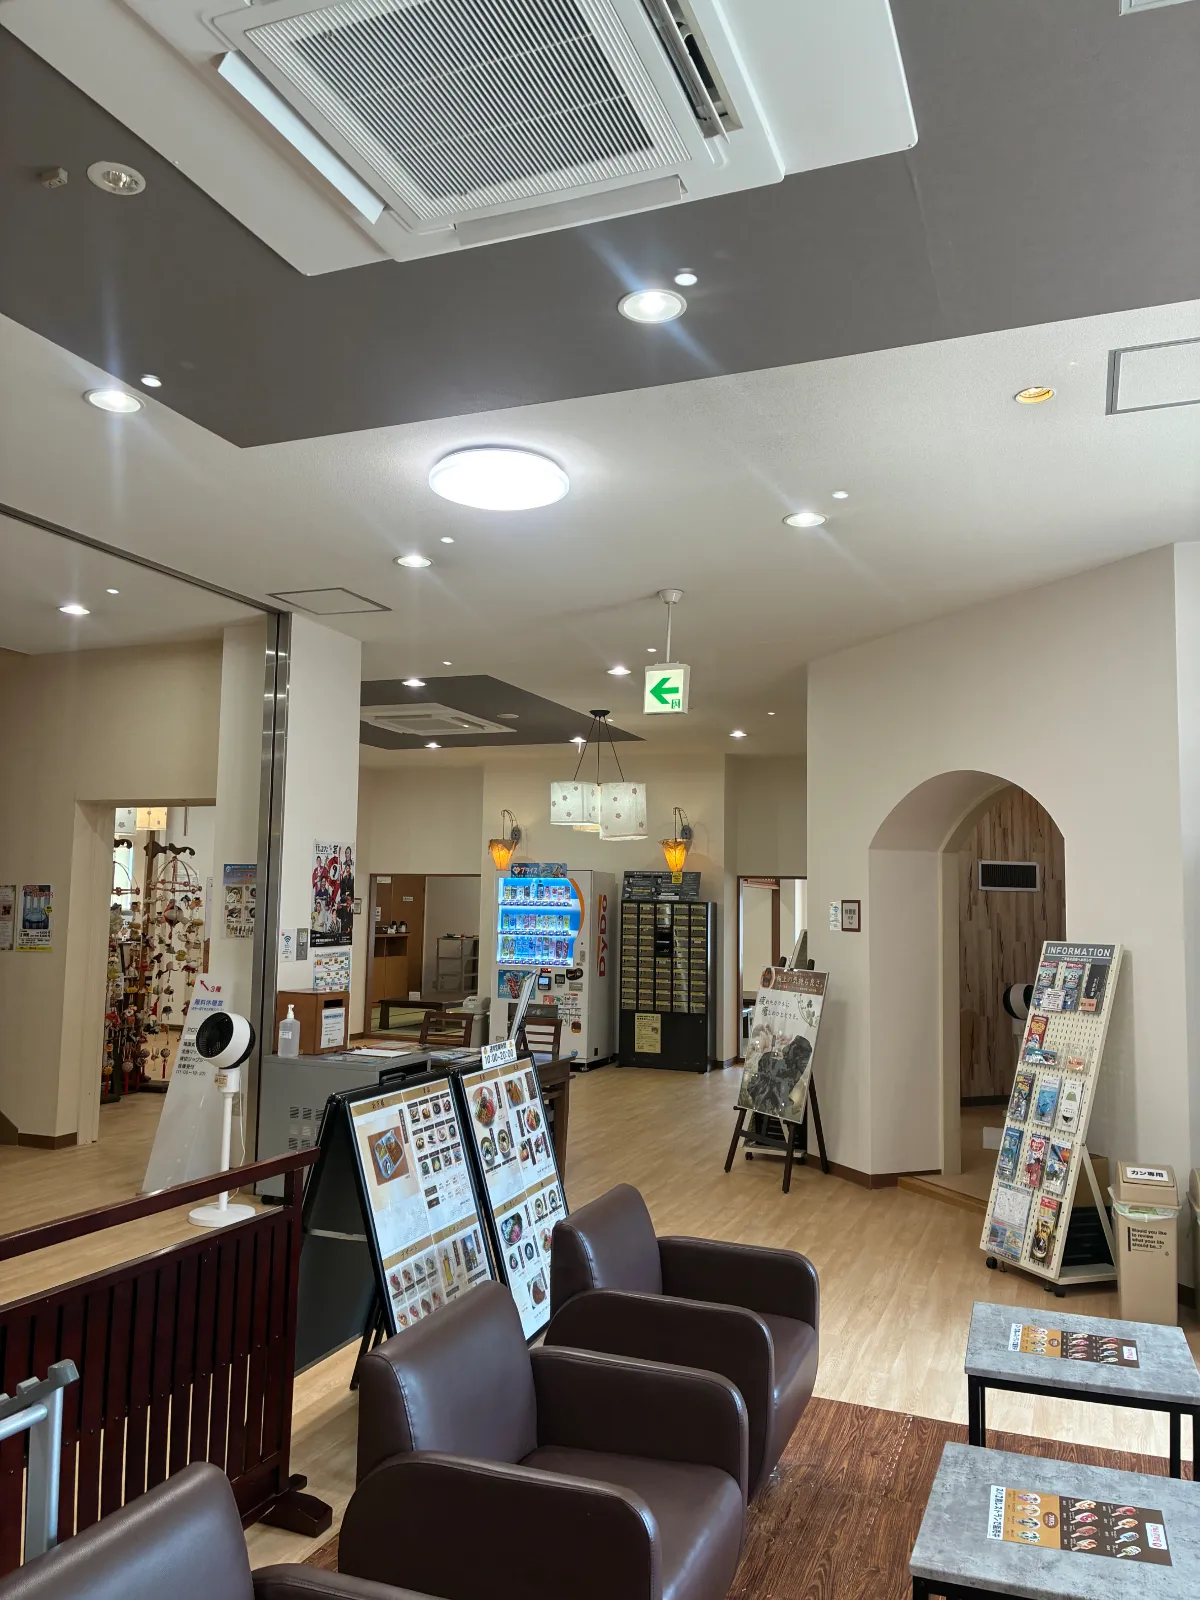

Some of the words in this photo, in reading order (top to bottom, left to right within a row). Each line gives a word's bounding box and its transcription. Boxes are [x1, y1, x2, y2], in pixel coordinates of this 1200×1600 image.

[1047, 946, 1111, 957] INFORMATION
[1131, 1169, 1164, 1178] カン専用
